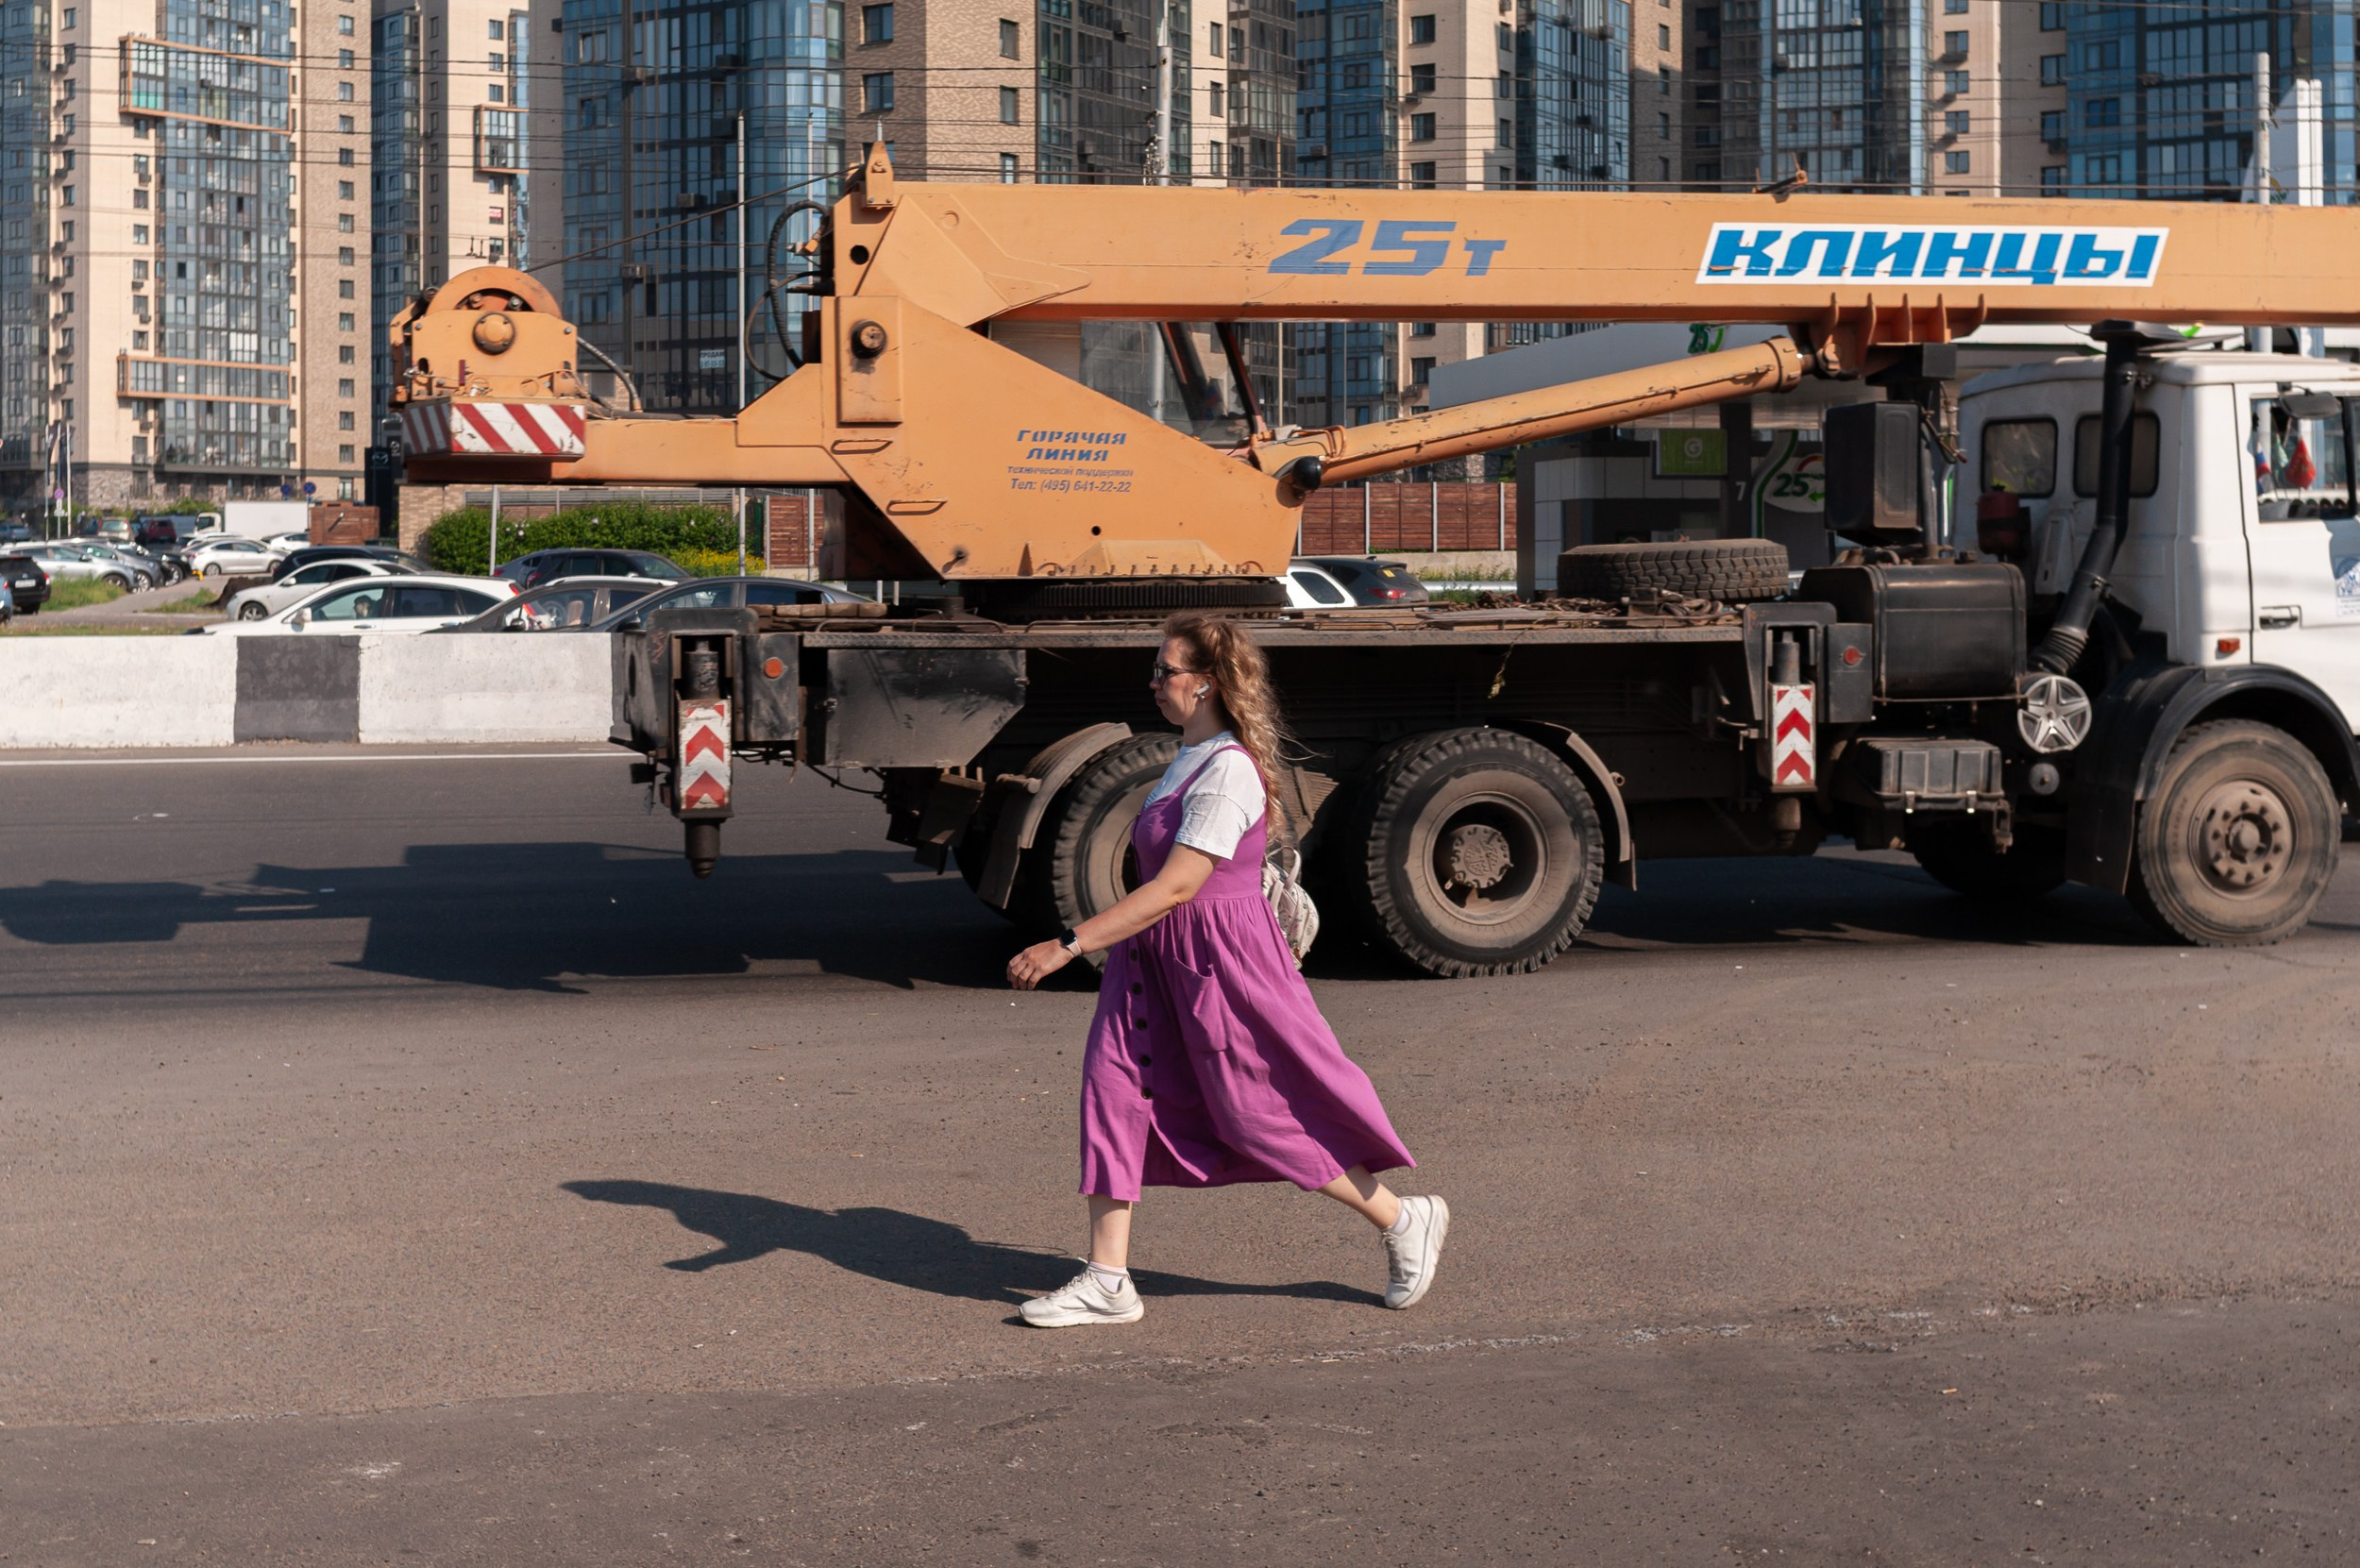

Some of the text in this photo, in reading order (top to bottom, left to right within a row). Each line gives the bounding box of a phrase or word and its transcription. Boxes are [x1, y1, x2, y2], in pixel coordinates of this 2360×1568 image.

[1705, 229, 2161, 285] КЛИНЦЫ
[1017, 430, 1127, 445] ГОРЯЧАЯ
[1026, 447, 1109, 462] ЛИНИЯ
[1007, 465, 1134, 479] технической поддержки
[1011, 478, 1132, 494] Тел: (495) 641-22-22
[1735, 481, 1746, 501] 7
